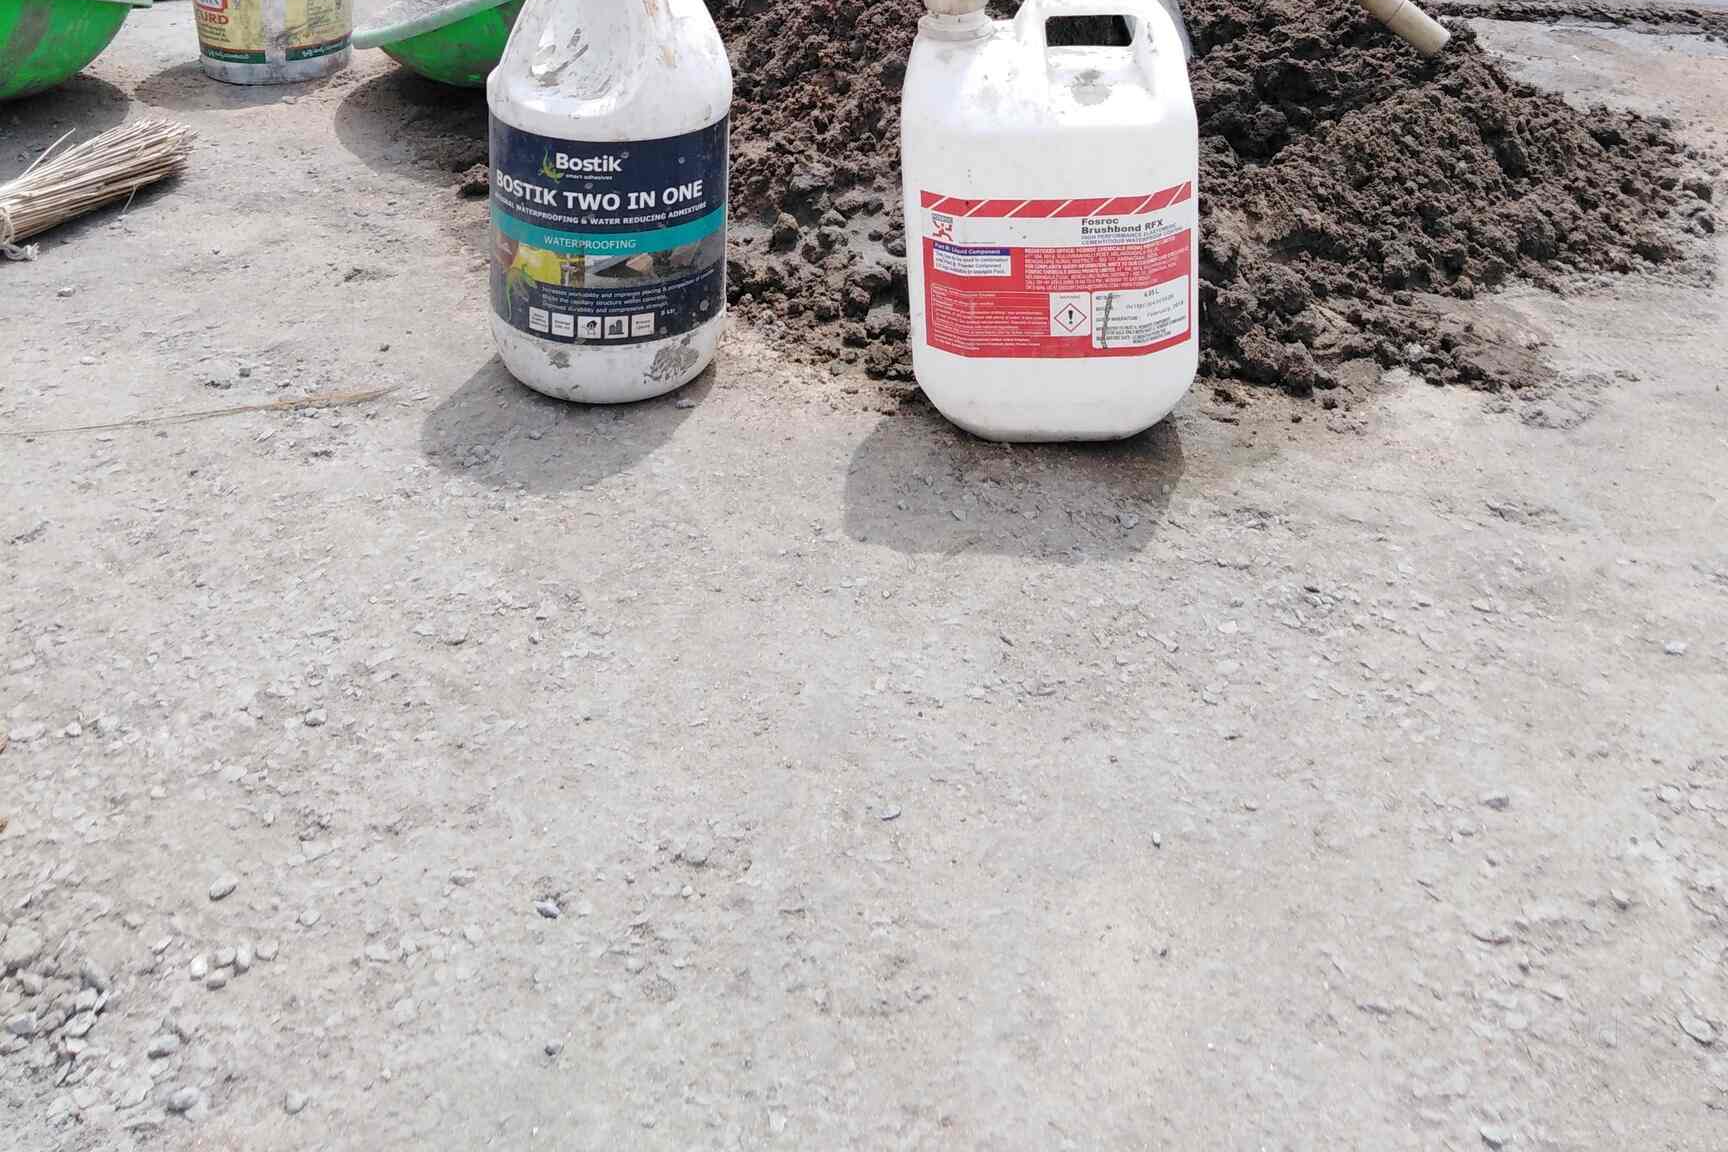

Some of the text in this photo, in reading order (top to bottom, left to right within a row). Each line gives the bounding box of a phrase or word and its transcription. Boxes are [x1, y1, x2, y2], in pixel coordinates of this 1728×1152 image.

[555, 152, 622, 172] Bostik
[496, 169, 558, 207] BOSTIK
[563, 192, 620, 211] TWO
[627, 190, 656, 210] IN
[662, 179, 703, 205] ONE
[516, 201, 707, 225] WATERPROOFING & WATER REDUCING ADMIXTURE
[1081, 218, 1119, 226] Fosroc
[1081, 219, 1164, 234] Brushbond RFX
[544, 235, 637, 250] WATERPROOFING
